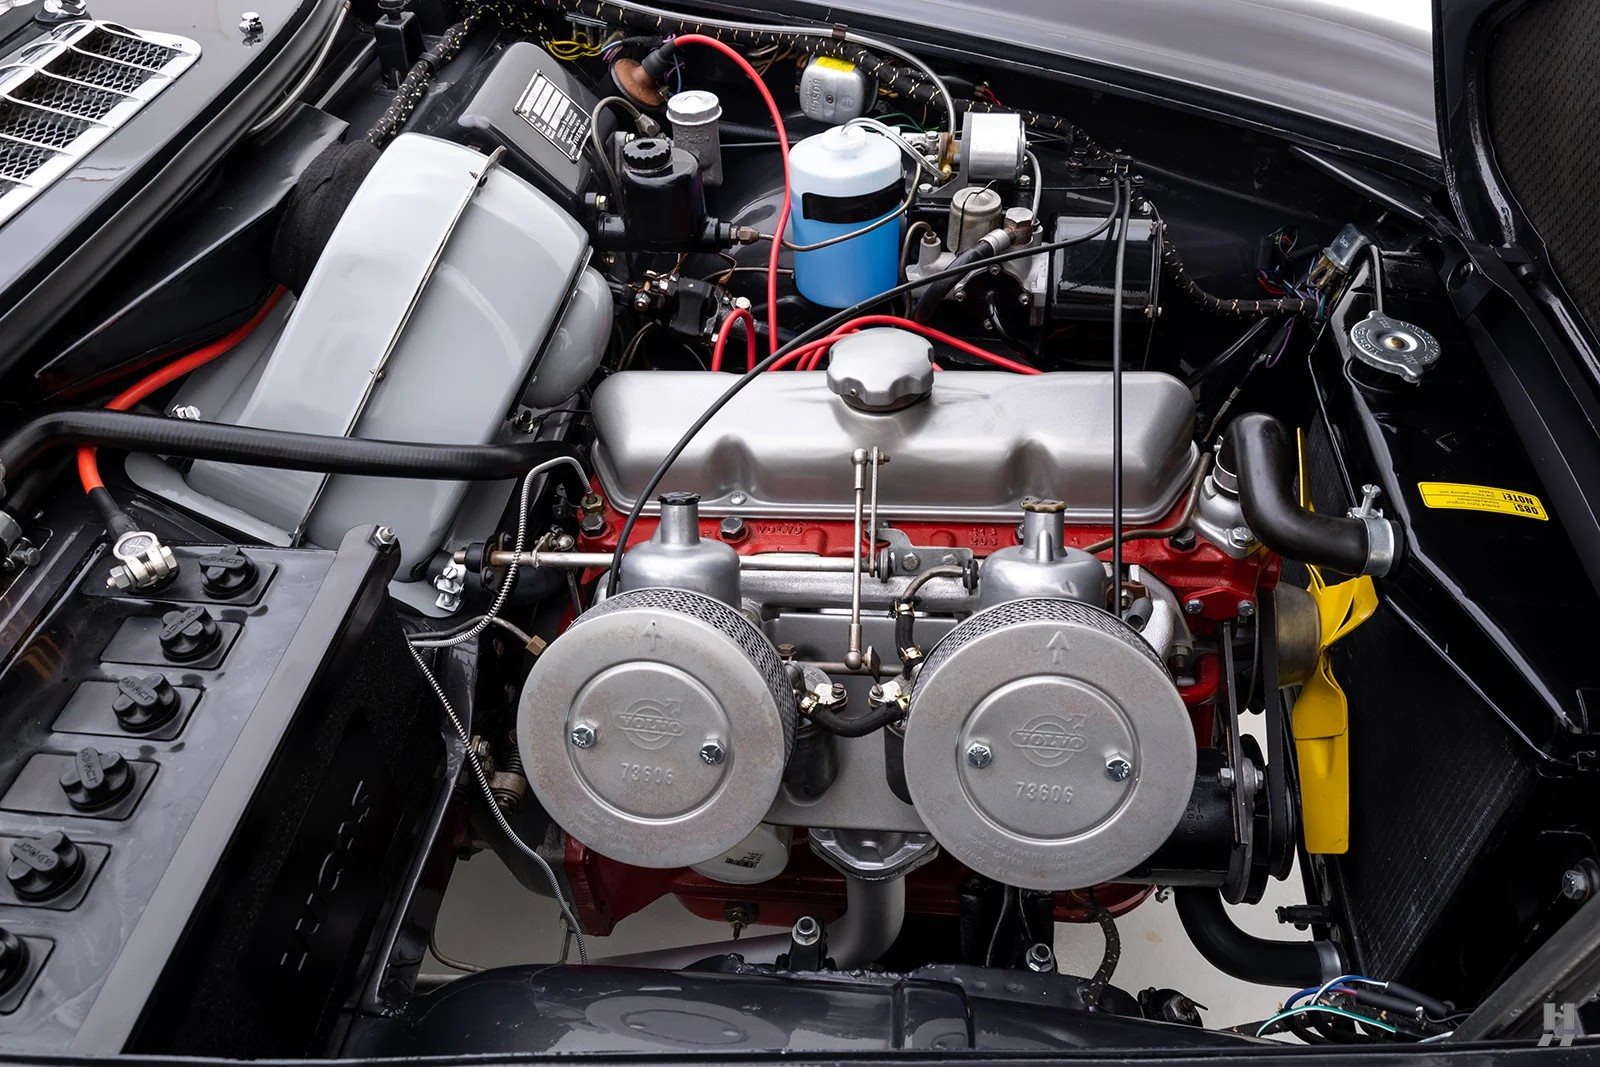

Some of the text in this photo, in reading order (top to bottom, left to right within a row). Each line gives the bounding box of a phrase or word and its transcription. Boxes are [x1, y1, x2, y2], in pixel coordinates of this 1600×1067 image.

[1502, 492, 1534, 505] NOTE!
[1514, 503, 1539, 515] OBS!
[756, 525, 803, 535] VOLVO
[619, 715, 681, 733] VOLVO
[1016, 732, 1085, 749] VOLVO
[621, 763, 674, 785] 73606
[1016, 781, 1074, 803] 73606
